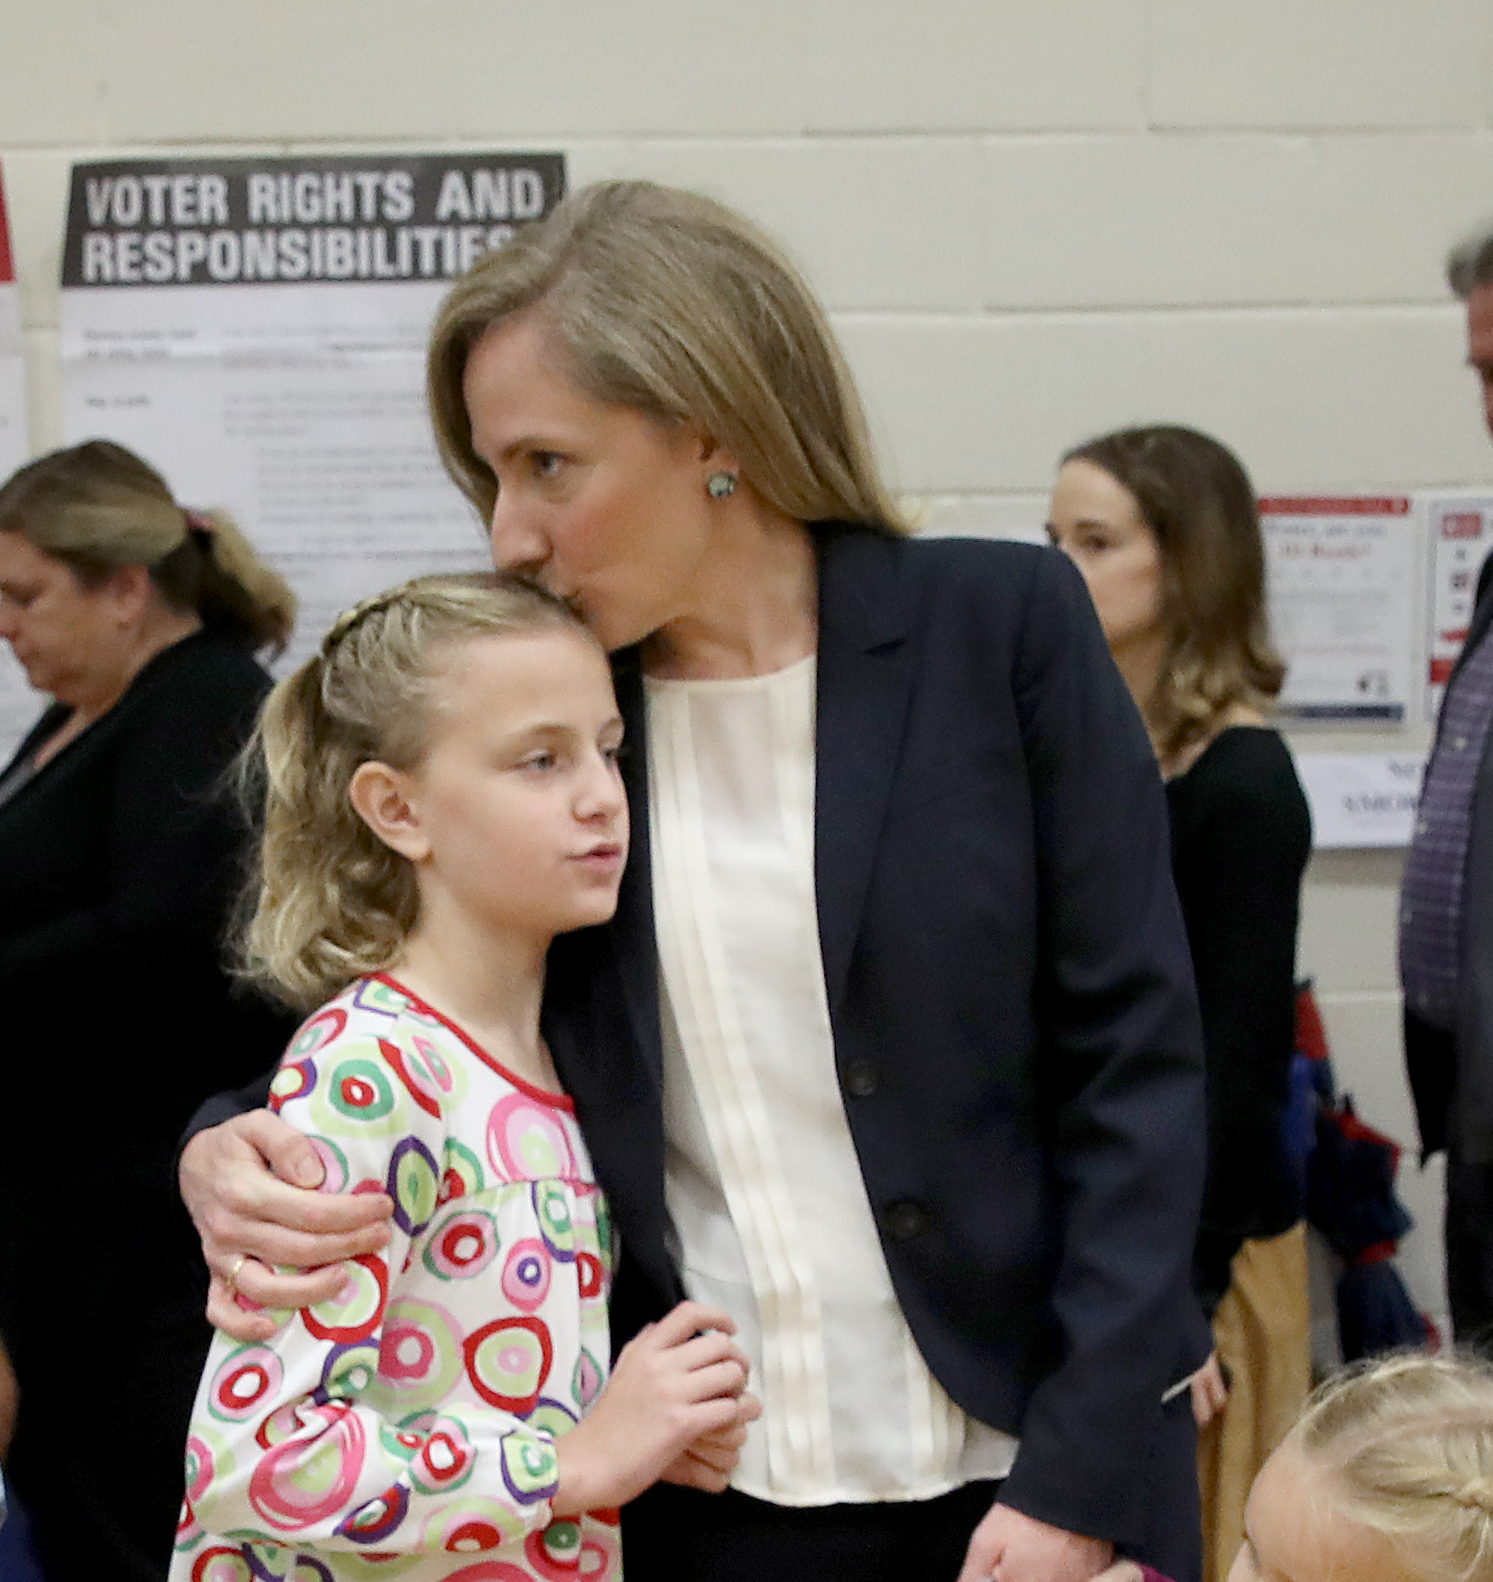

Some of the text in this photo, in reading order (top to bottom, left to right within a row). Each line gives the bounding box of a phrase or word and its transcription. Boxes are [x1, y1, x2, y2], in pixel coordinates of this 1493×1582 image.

[84, 167, 545, 227] VOTER RIGHTS AND
